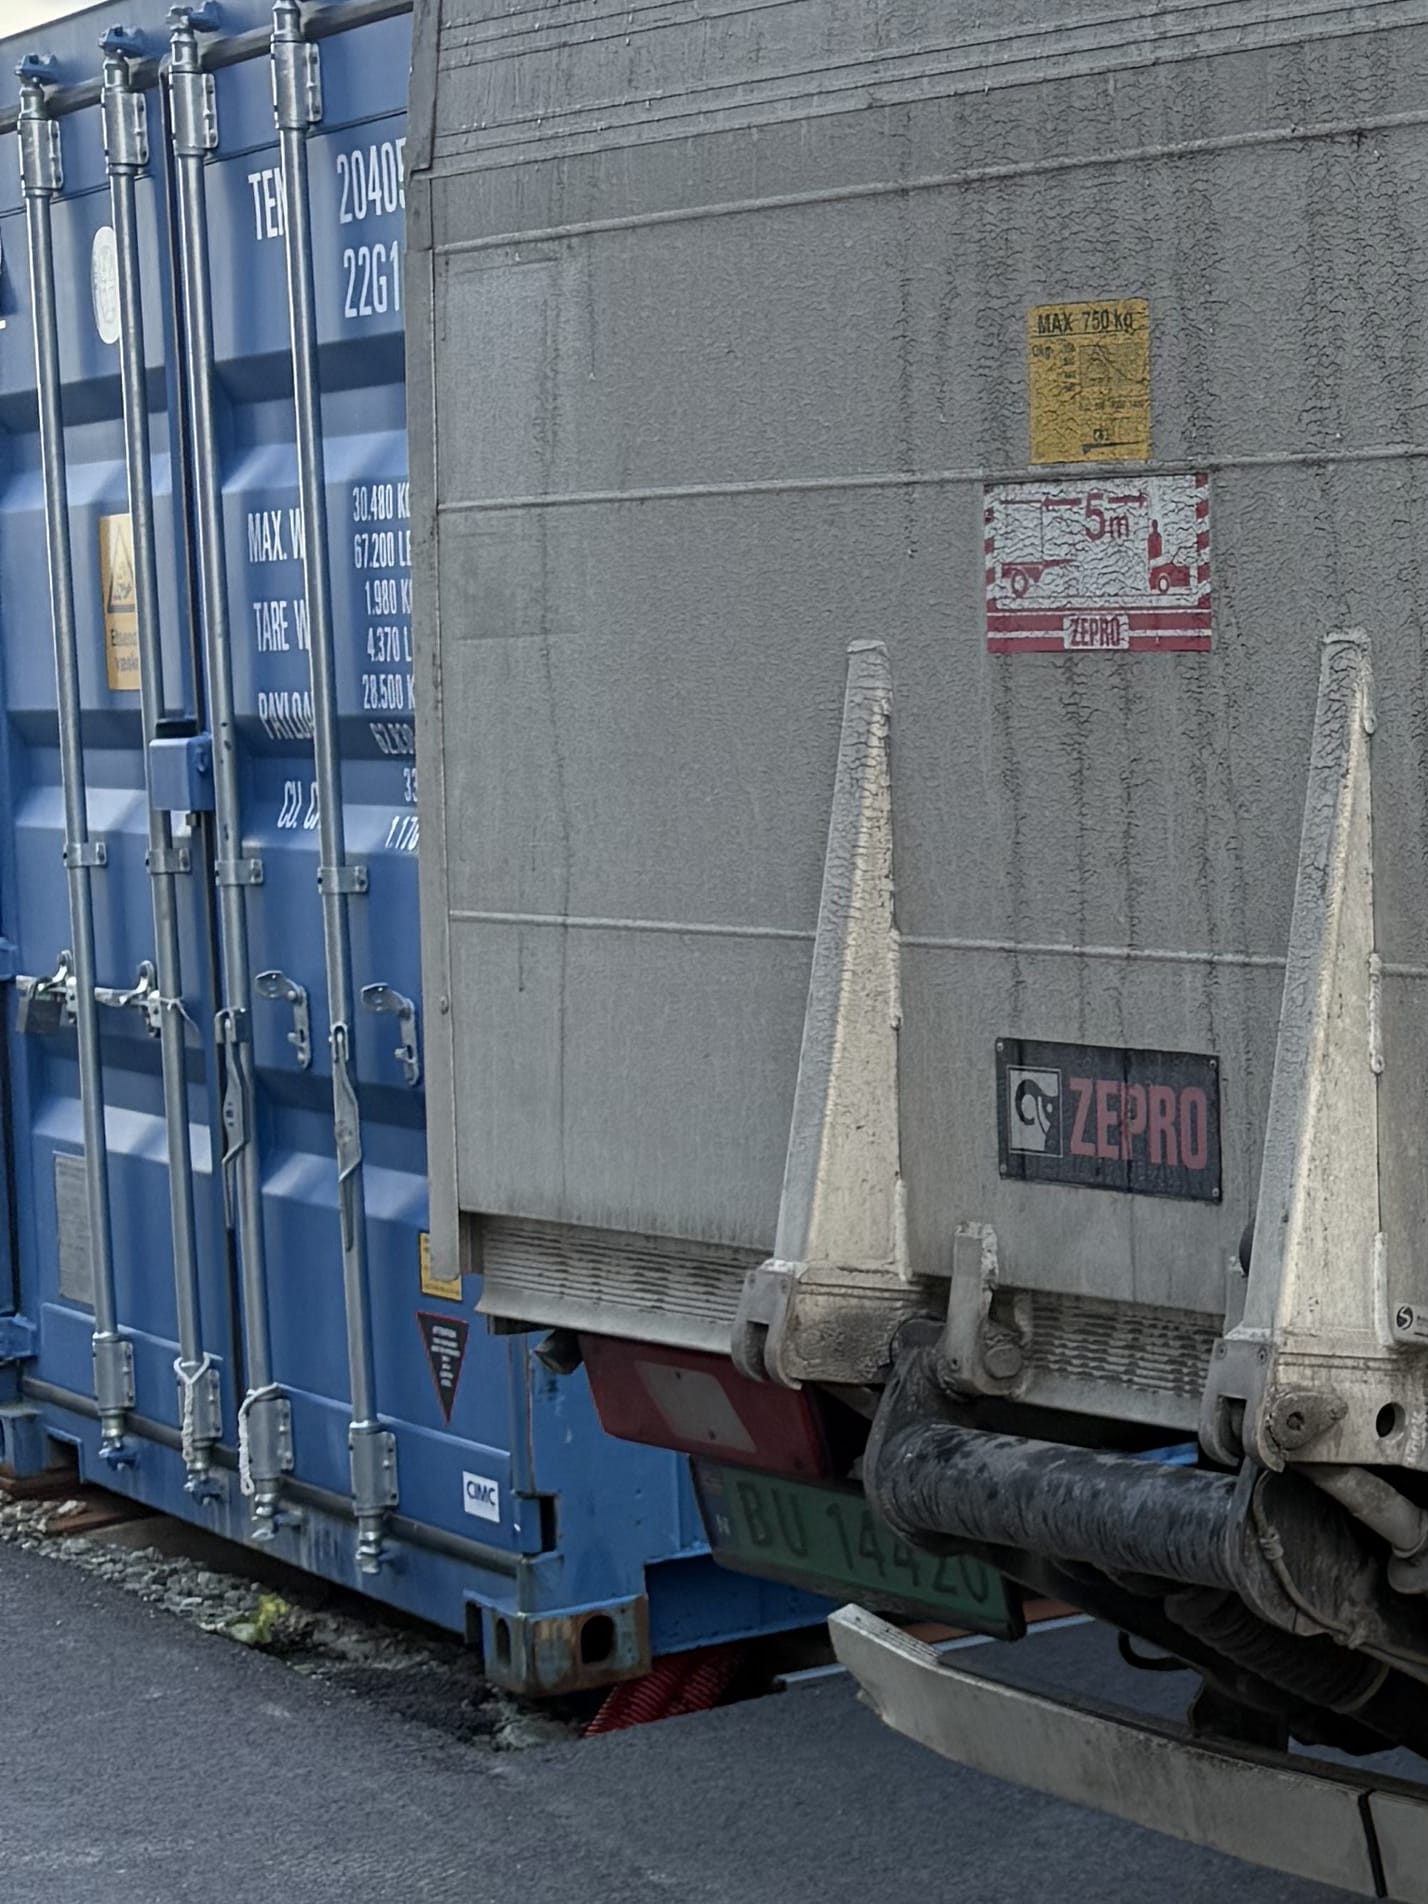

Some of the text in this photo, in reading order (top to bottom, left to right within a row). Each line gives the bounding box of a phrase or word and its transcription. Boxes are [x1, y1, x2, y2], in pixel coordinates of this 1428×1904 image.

[343, 240, 400, 318] 22G1
[1037, 309, 1133, 334] MAX 750 kg
[247, 510, 288, 563] MAX.
[352, 484, 393, 522] 30.480
[354, 532, 394, 568] 67.200
[253, 601, 290, 652] TARE
[365, 580, 397, 615] 1.980
[1070, 617, 1120, 647] ZEPRO
[367, 626, 400, 662] 4.370
[362, 674, 403, 710] 28.500
[1069, 1077, 1208, 1170] ZEPRO
[467, 1480, 496, 1506] CIMC
[736, 1479, 809, 1558] BU
